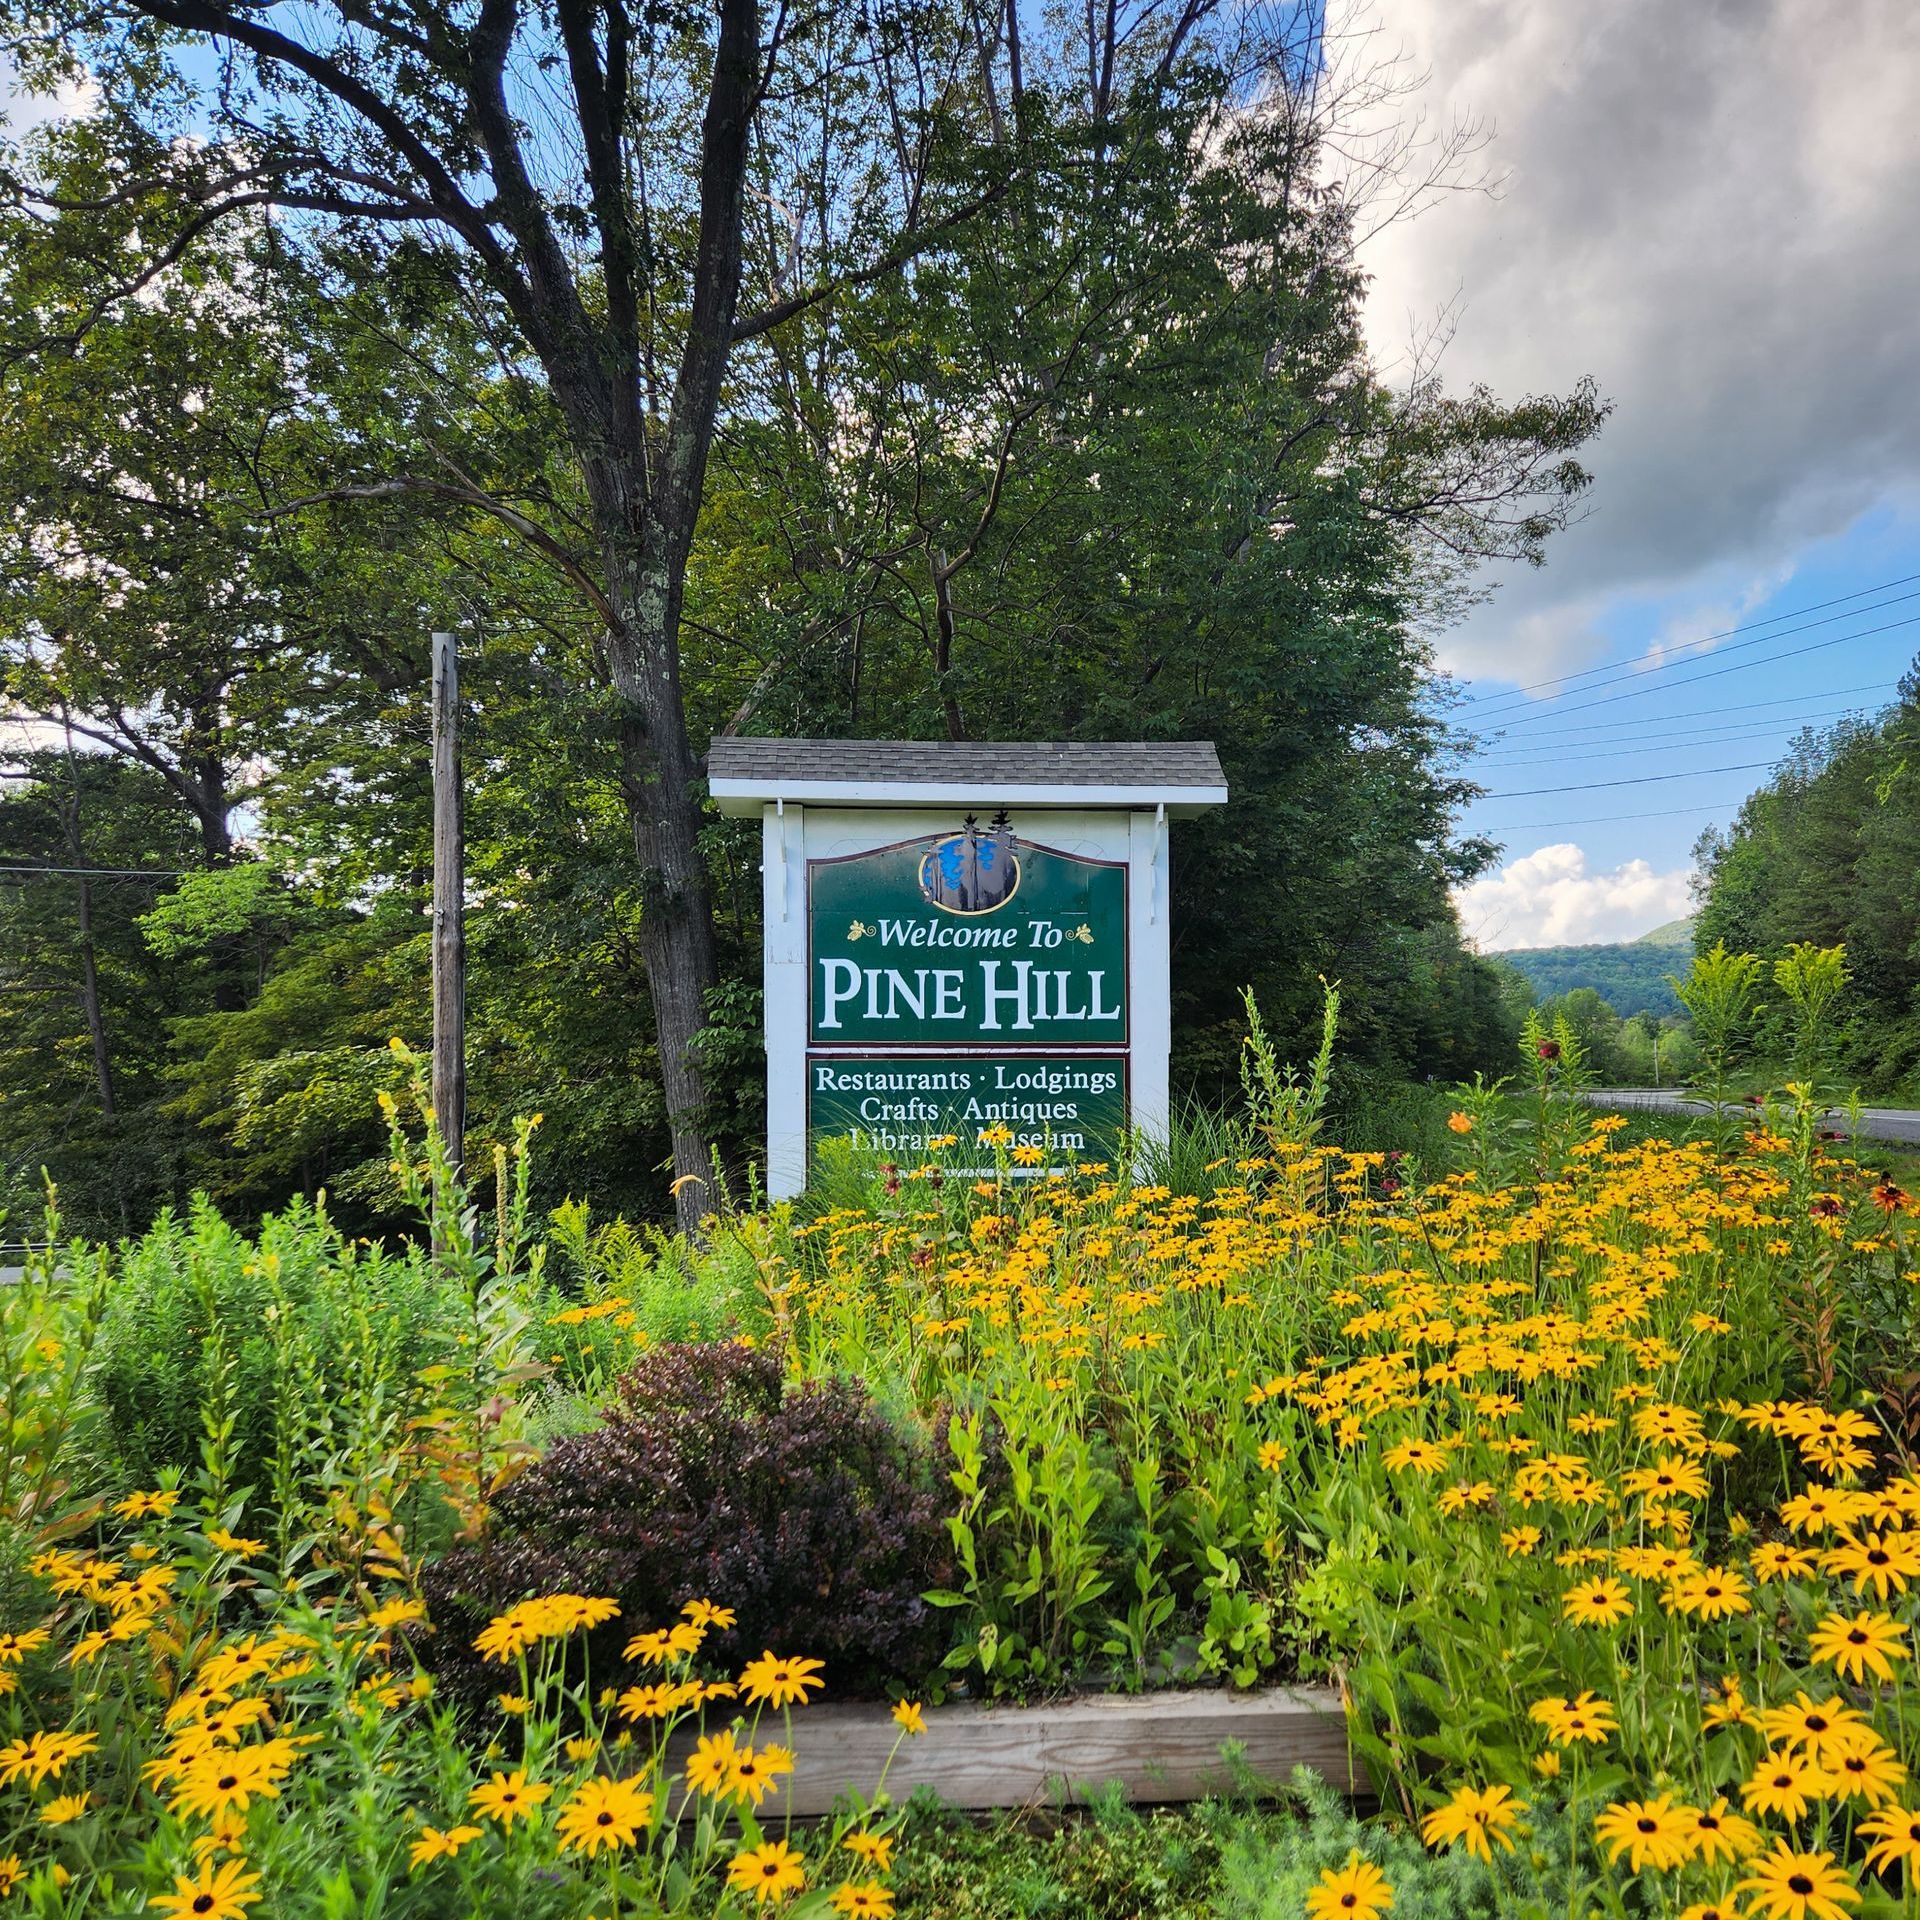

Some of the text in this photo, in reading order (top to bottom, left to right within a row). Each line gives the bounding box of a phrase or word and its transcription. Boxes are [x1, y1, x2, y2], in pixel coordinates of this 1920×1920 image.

[878, 919, 1063, 948] Welcome To
[818, 958, 1121, 1030] PINE HILL
[816, 1066, 1117, 1094] Restaurants Lodgings
[860, 1097, 1078, 1125] Crafts Antiques
